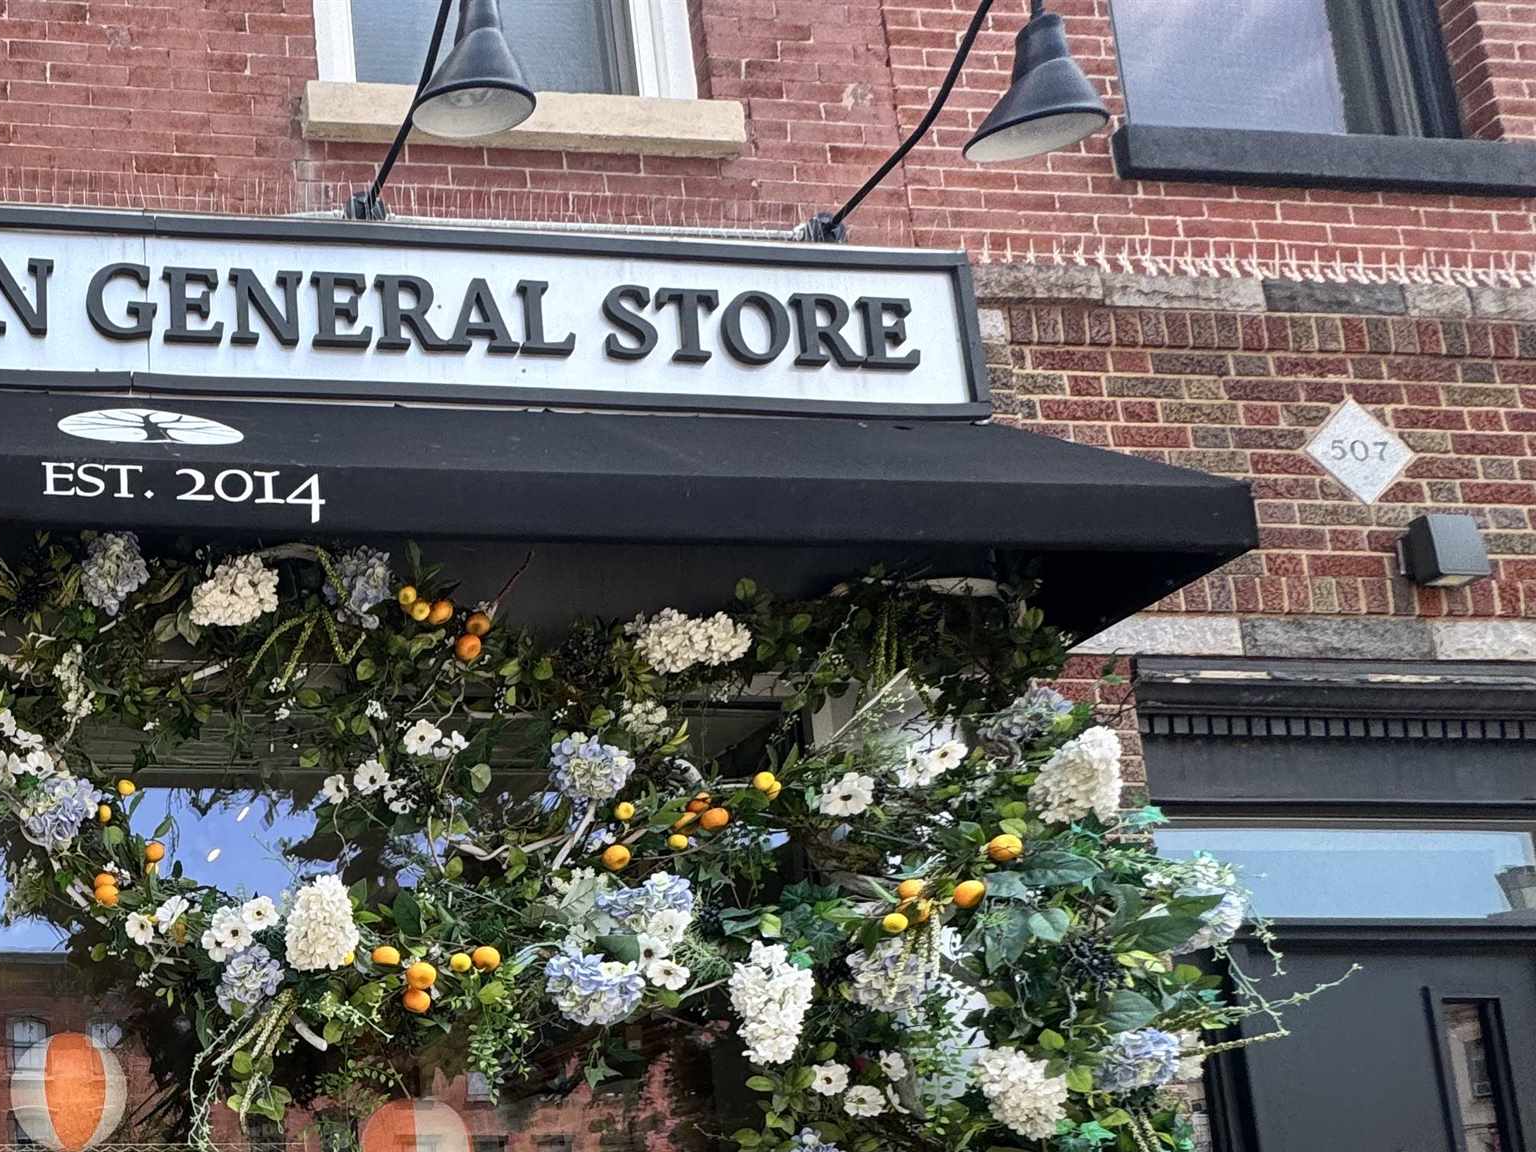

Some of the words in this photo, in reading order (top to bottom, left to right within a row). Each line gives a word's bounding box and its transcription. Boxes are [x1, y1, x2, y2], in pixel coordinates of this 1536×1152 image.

[85, 259, 576, 357] GENERAL
[603, 283, 921, 371] STORE
[1331, 439, 1388, 462] 507
[41, 461, 154, 499] EST.
[175, 467, 326, 523] 2014
